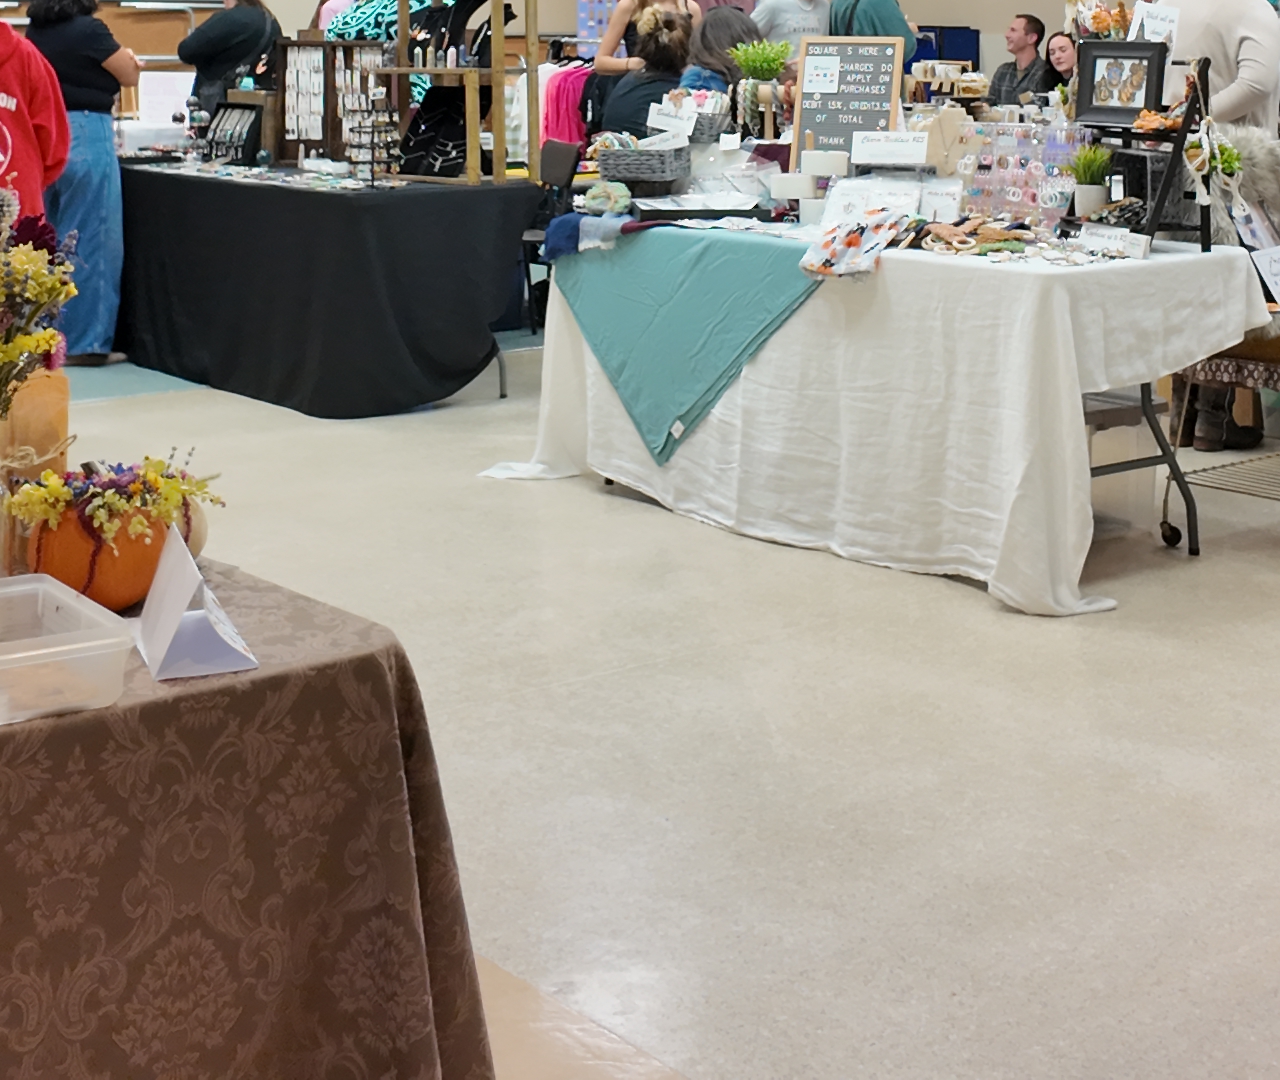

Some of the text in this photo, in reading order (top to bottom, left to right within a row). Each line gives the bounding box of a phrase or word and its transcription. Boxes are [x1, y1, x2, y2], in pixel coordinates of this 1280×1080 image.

[808, 46, 838, 54] SQUARE
[839, 63, 873, 71] CHARGES
[879, 75, 890, 83] ON
[839, 85, 886, 94] PURCHASES
[815, 114, 863, 124] OF TOTAL
[819, 136, 845, 145] THANK
